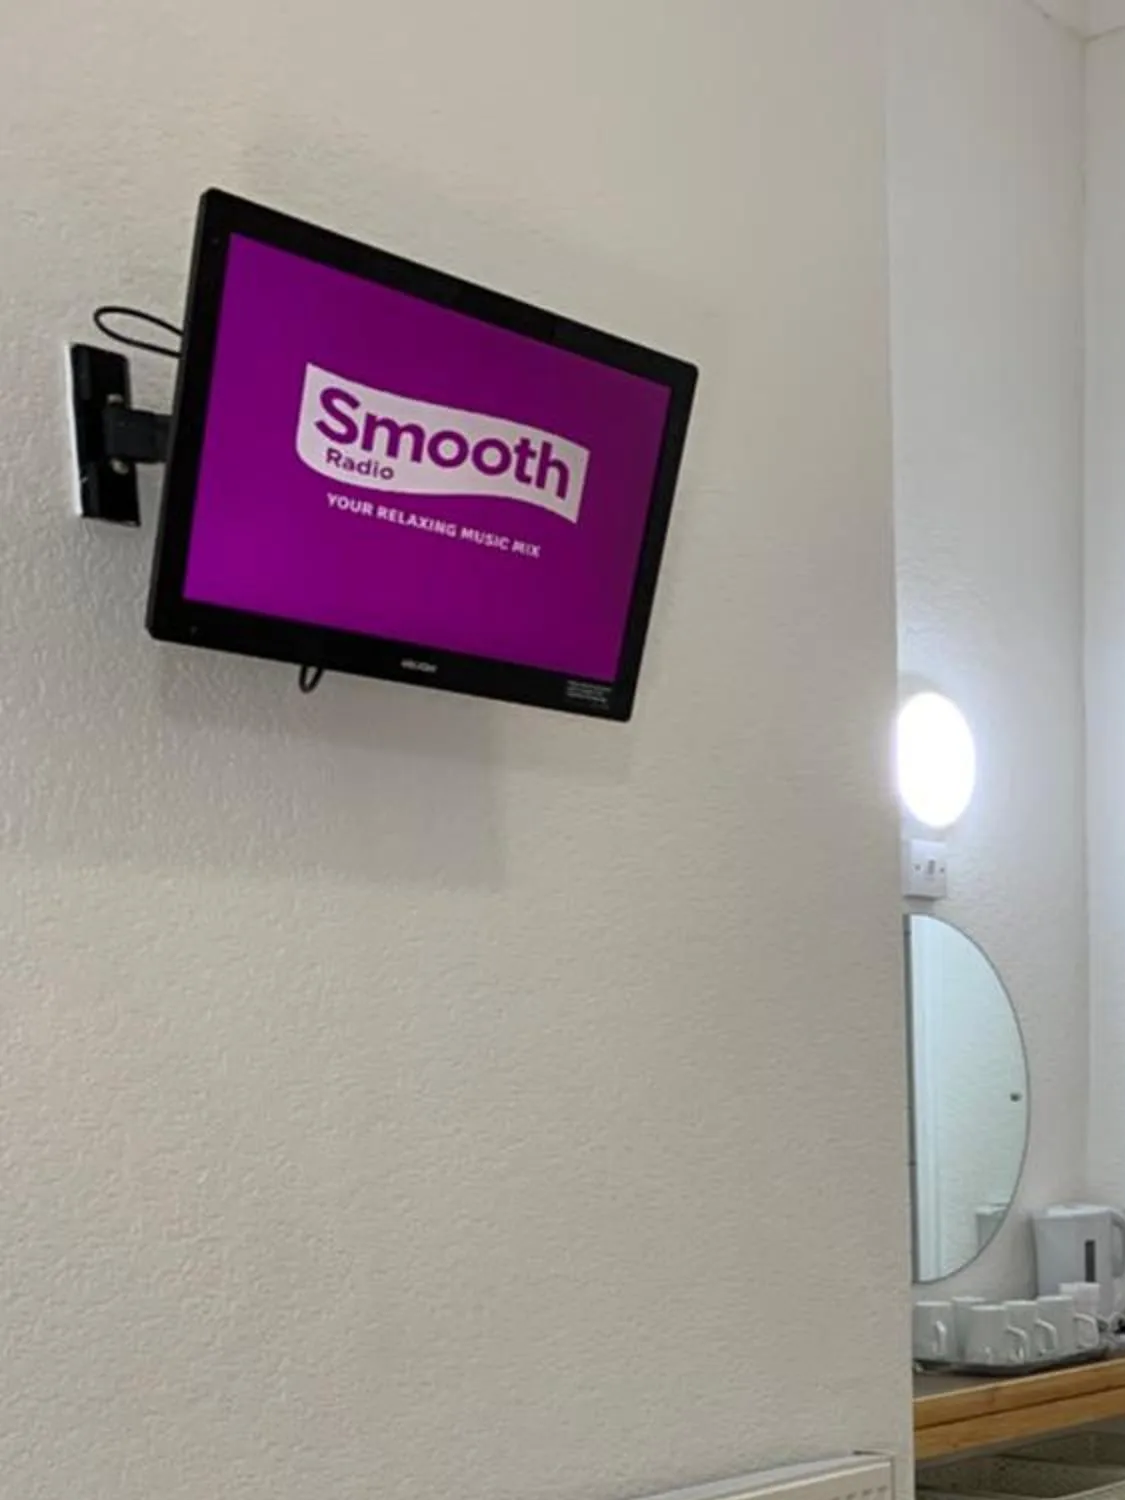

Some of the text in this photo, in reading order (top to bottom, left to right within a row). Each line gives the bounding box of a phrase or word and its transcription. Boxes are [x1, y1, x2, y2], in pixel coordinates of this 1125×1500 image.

[315, 387, 569, 500] Smooth
[325, 448, 394, 481] Radio
[326, 492, 541, 558] YOUR RELAXING MUSIC MIX
